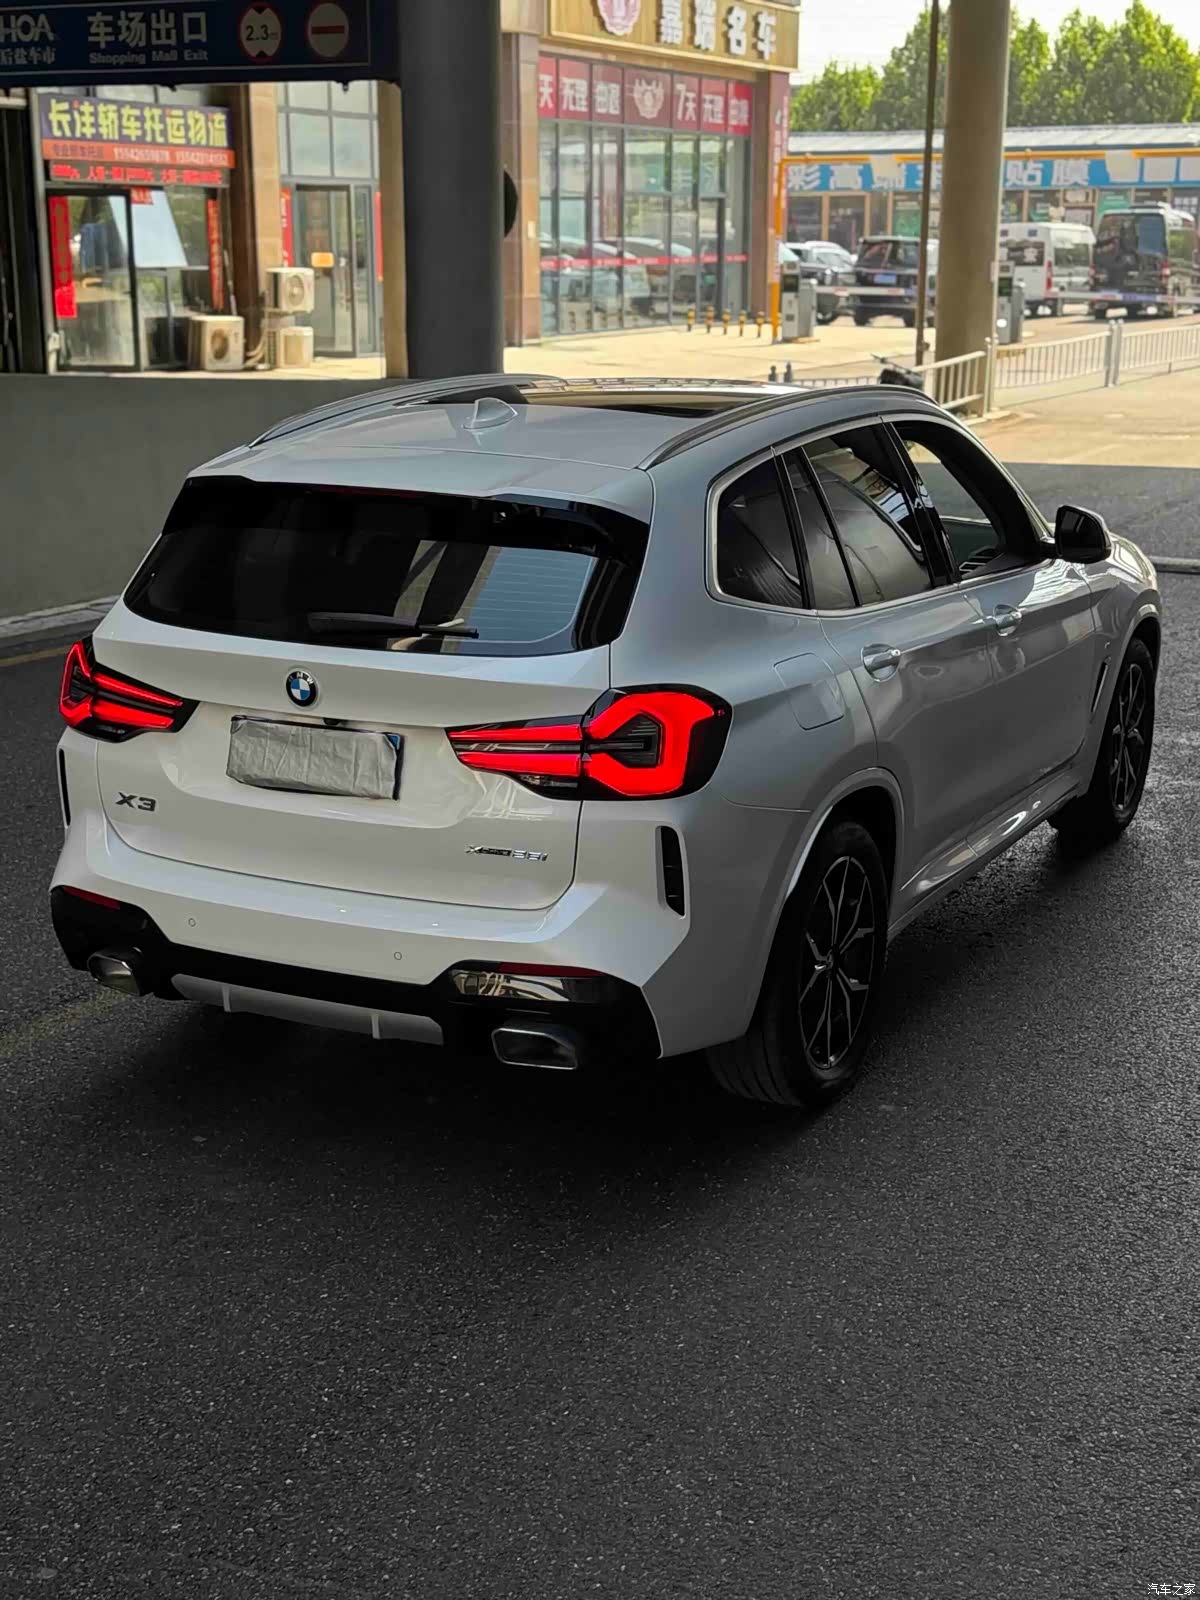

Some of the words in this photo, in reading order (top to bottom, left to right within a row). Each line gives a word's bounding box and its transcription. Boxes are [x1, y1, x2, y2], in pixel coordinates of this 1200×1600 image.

[88, 8, 208, 48] 车场出口
[89, 52, 146, 65] Shopping
[152, 50, 178, 62] Mall
[184, 49, 208, 61] Exit
[115, 791, 156, 812] X3
